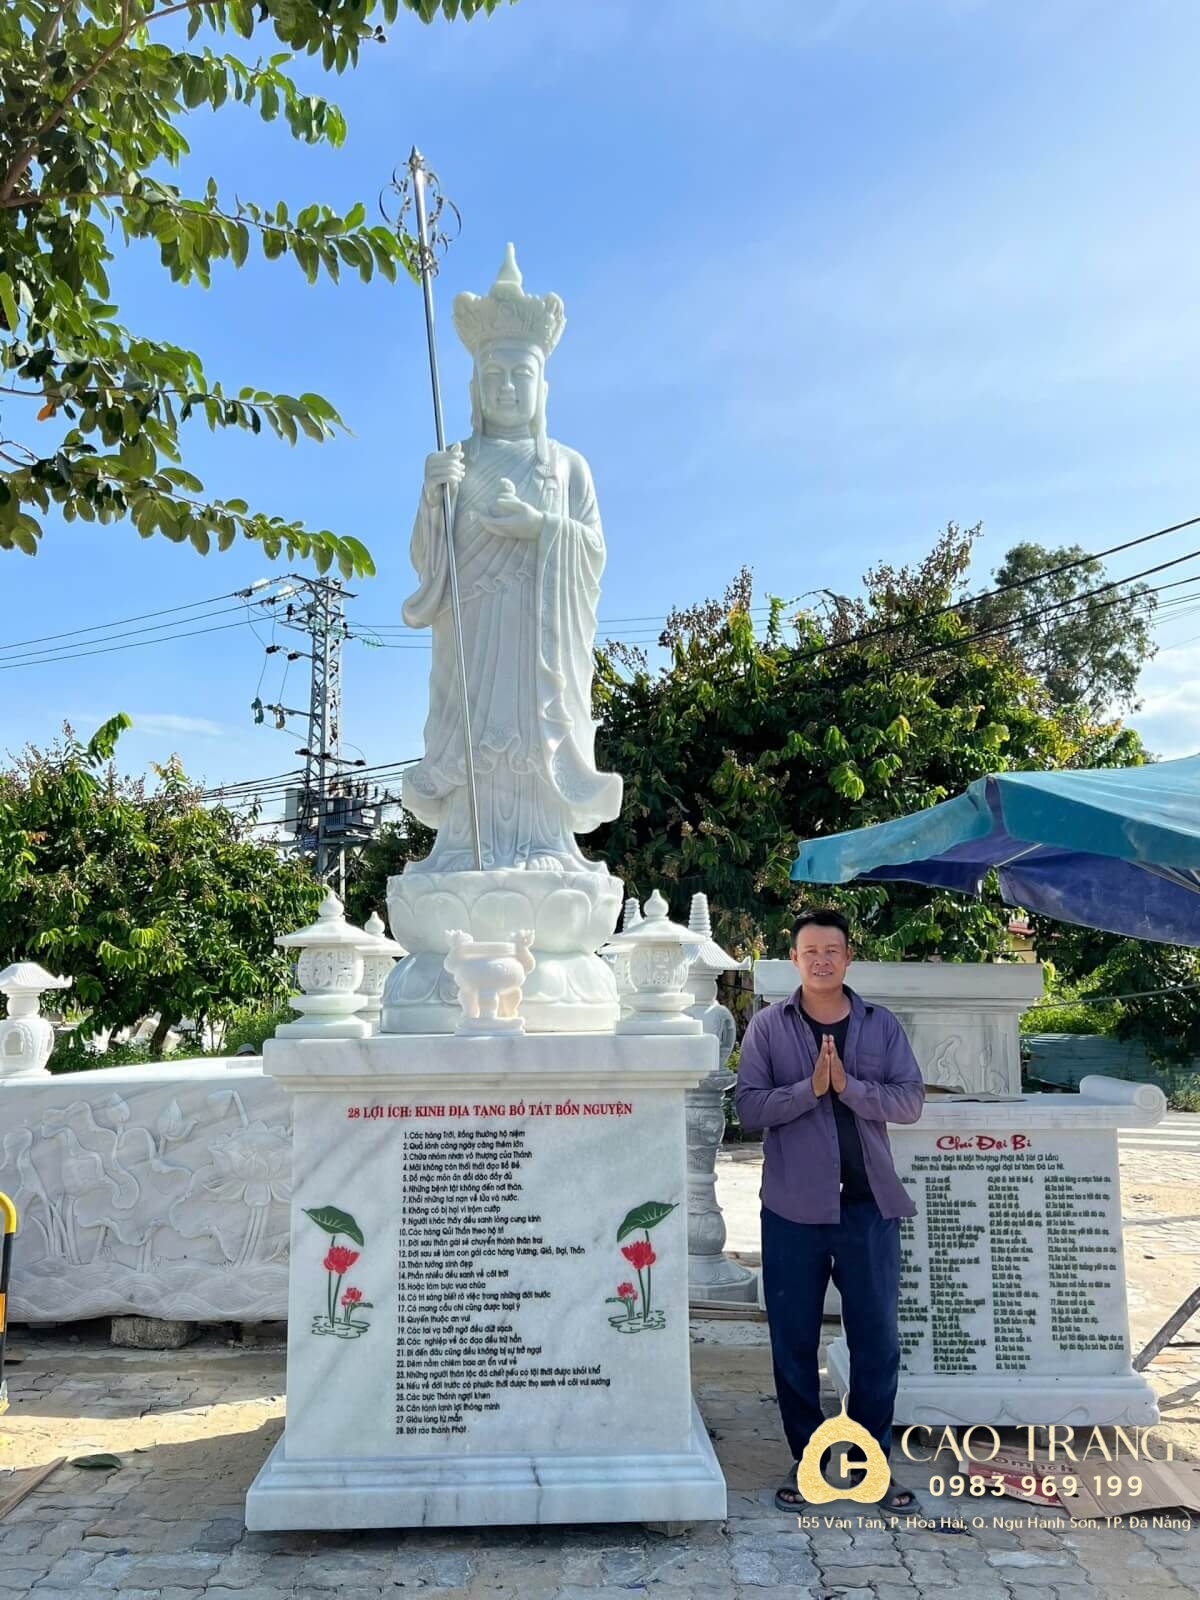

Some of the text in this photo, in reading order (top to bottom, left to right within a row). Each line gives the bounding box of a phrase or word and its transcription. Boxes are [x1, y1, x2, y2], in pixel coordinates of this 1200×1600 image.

[348, 1106, 360, 1119] 28
[415, 1105, 445, 1117] KINH
[449, 1104, 470, 1119] ĐỊA
[473, 1104, 506, 1118] TẠNG
[529, 1101, 552, 1116] TÁT
[583, 1101, 632, 1117] NGUYỆN
[1011, 1134, 1033, 1151] Bi
